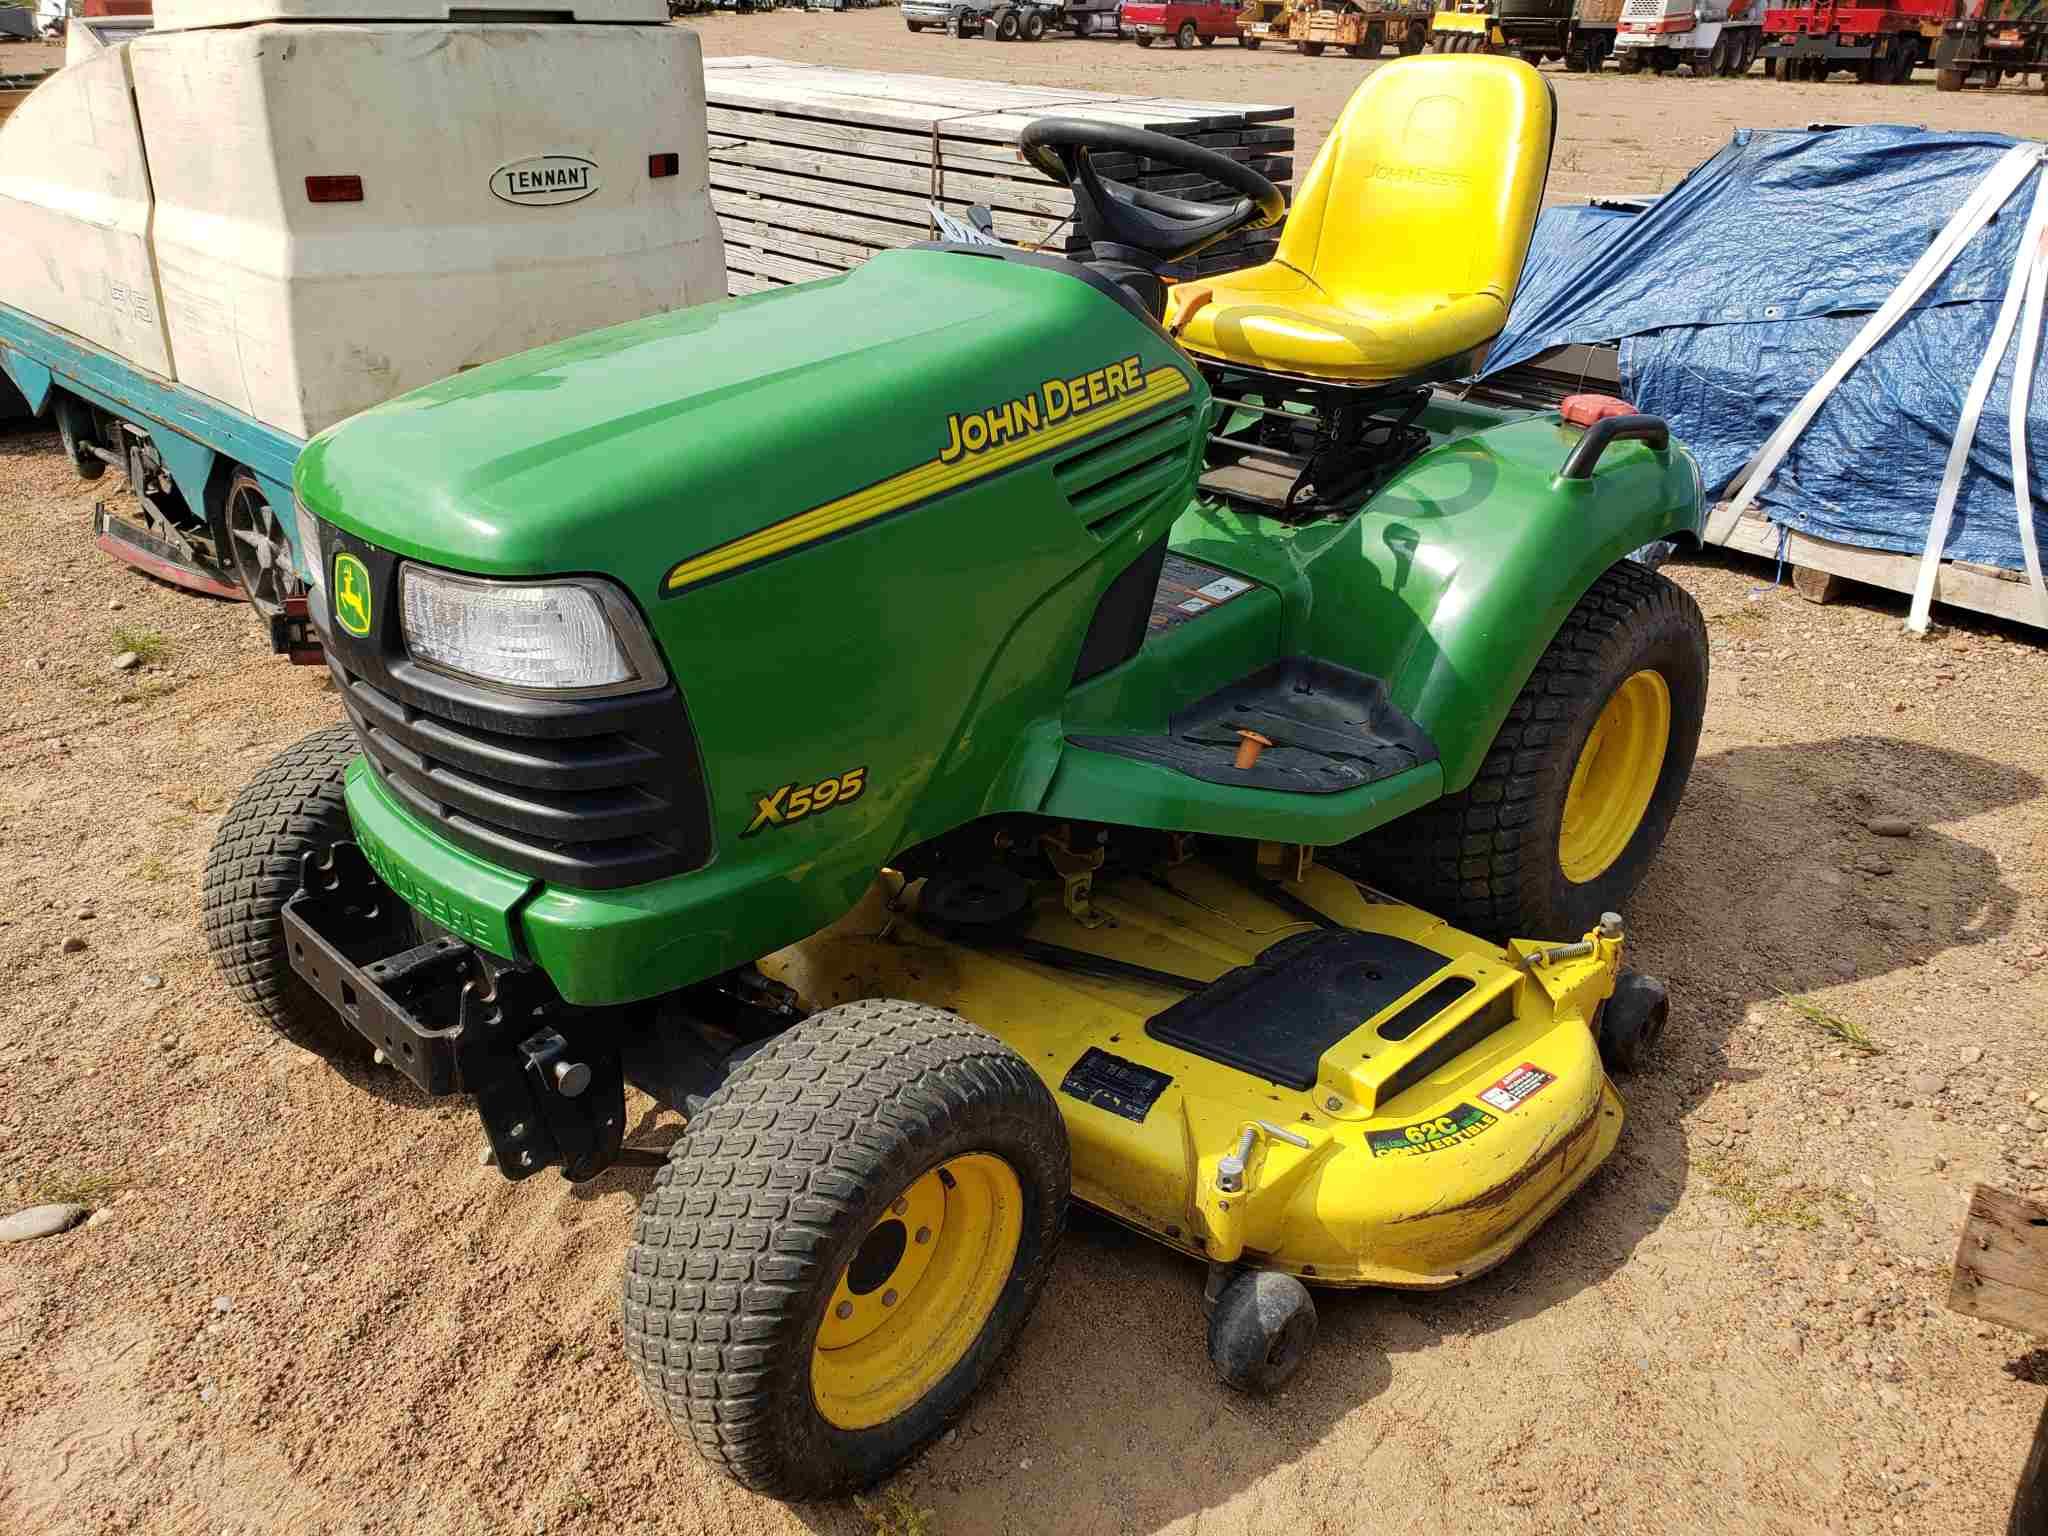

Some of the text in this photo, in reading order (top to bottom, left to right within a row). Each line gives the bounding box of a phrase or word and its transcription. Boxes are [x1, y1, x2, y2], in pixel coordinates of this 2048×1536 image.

[506, 167, 589, 195] TENNANT
[940, 354, 1146, 463] JOHN DEERE
[744, 767, 865, 836] X595
[1405, 1116, 1457, 1144] 62C
